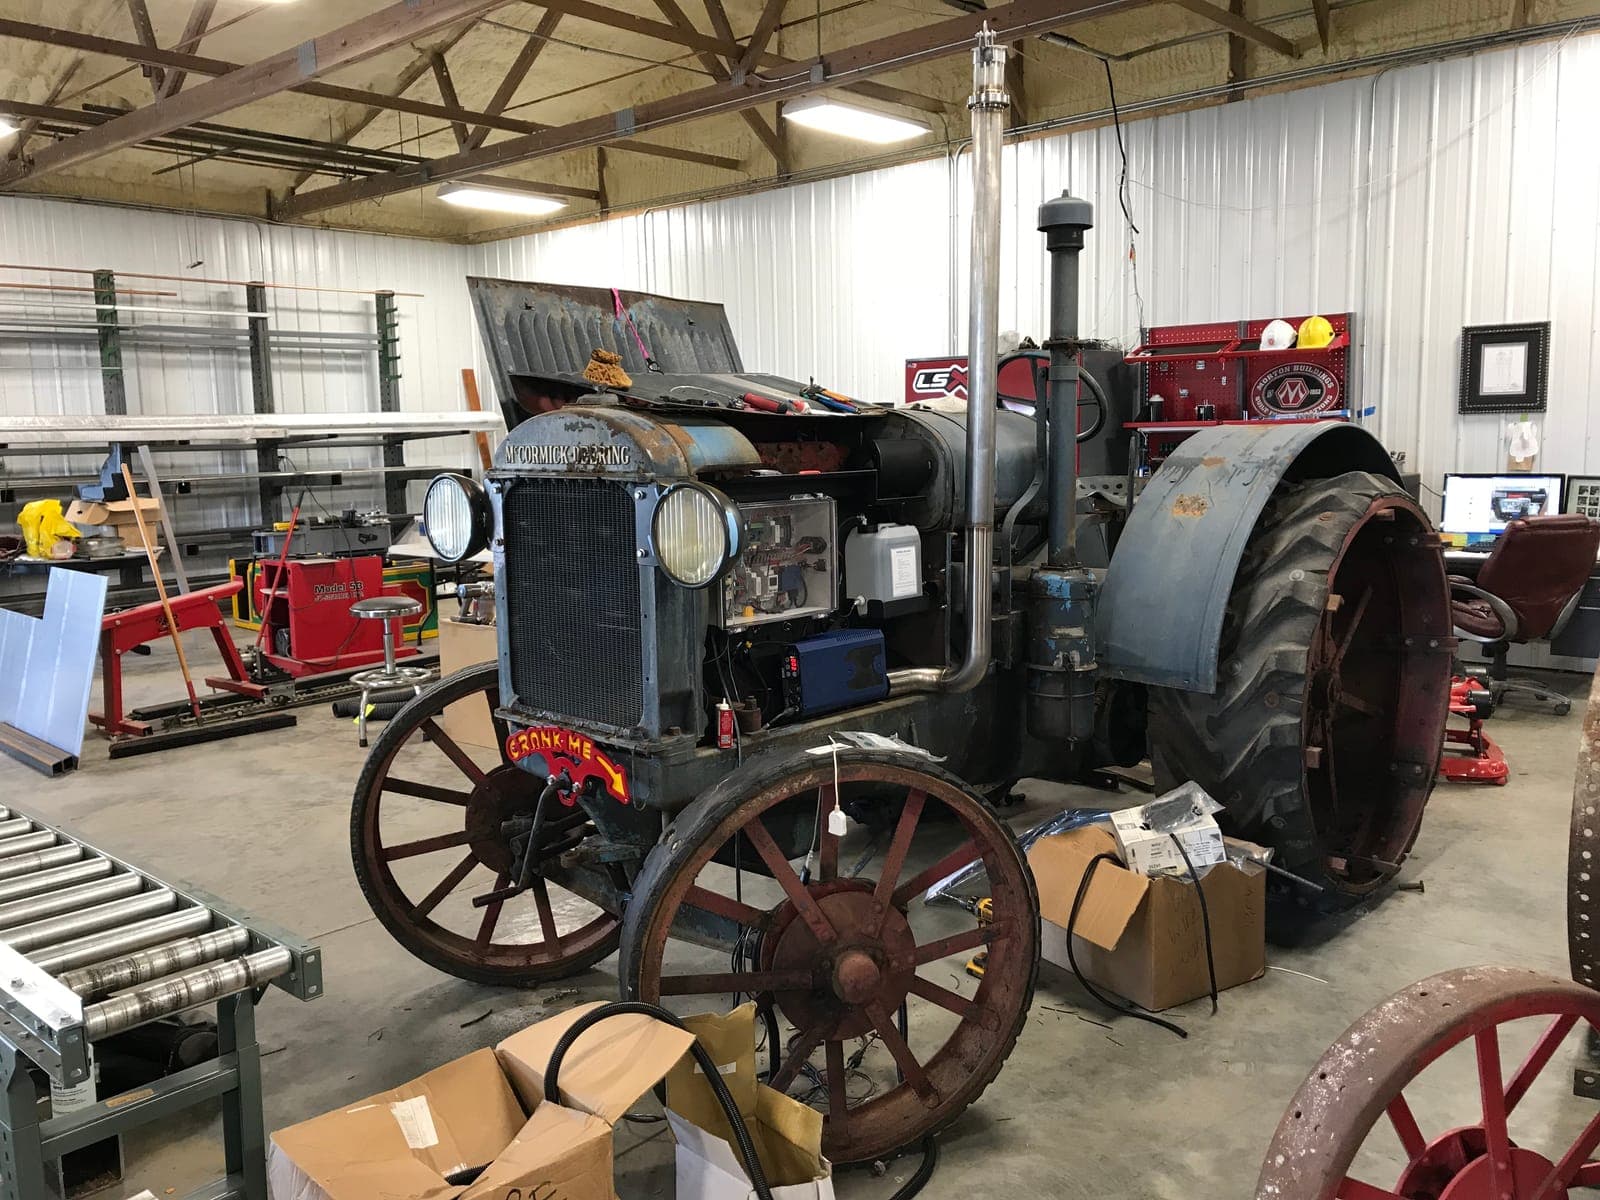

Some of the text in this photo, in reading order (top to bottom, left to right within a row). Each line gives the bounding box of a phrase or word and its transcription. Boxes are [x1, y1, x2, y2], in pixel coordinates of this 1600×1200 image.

[314, 583, 346, 594] Model
[509, 730, 592, 761] CRANK ME
